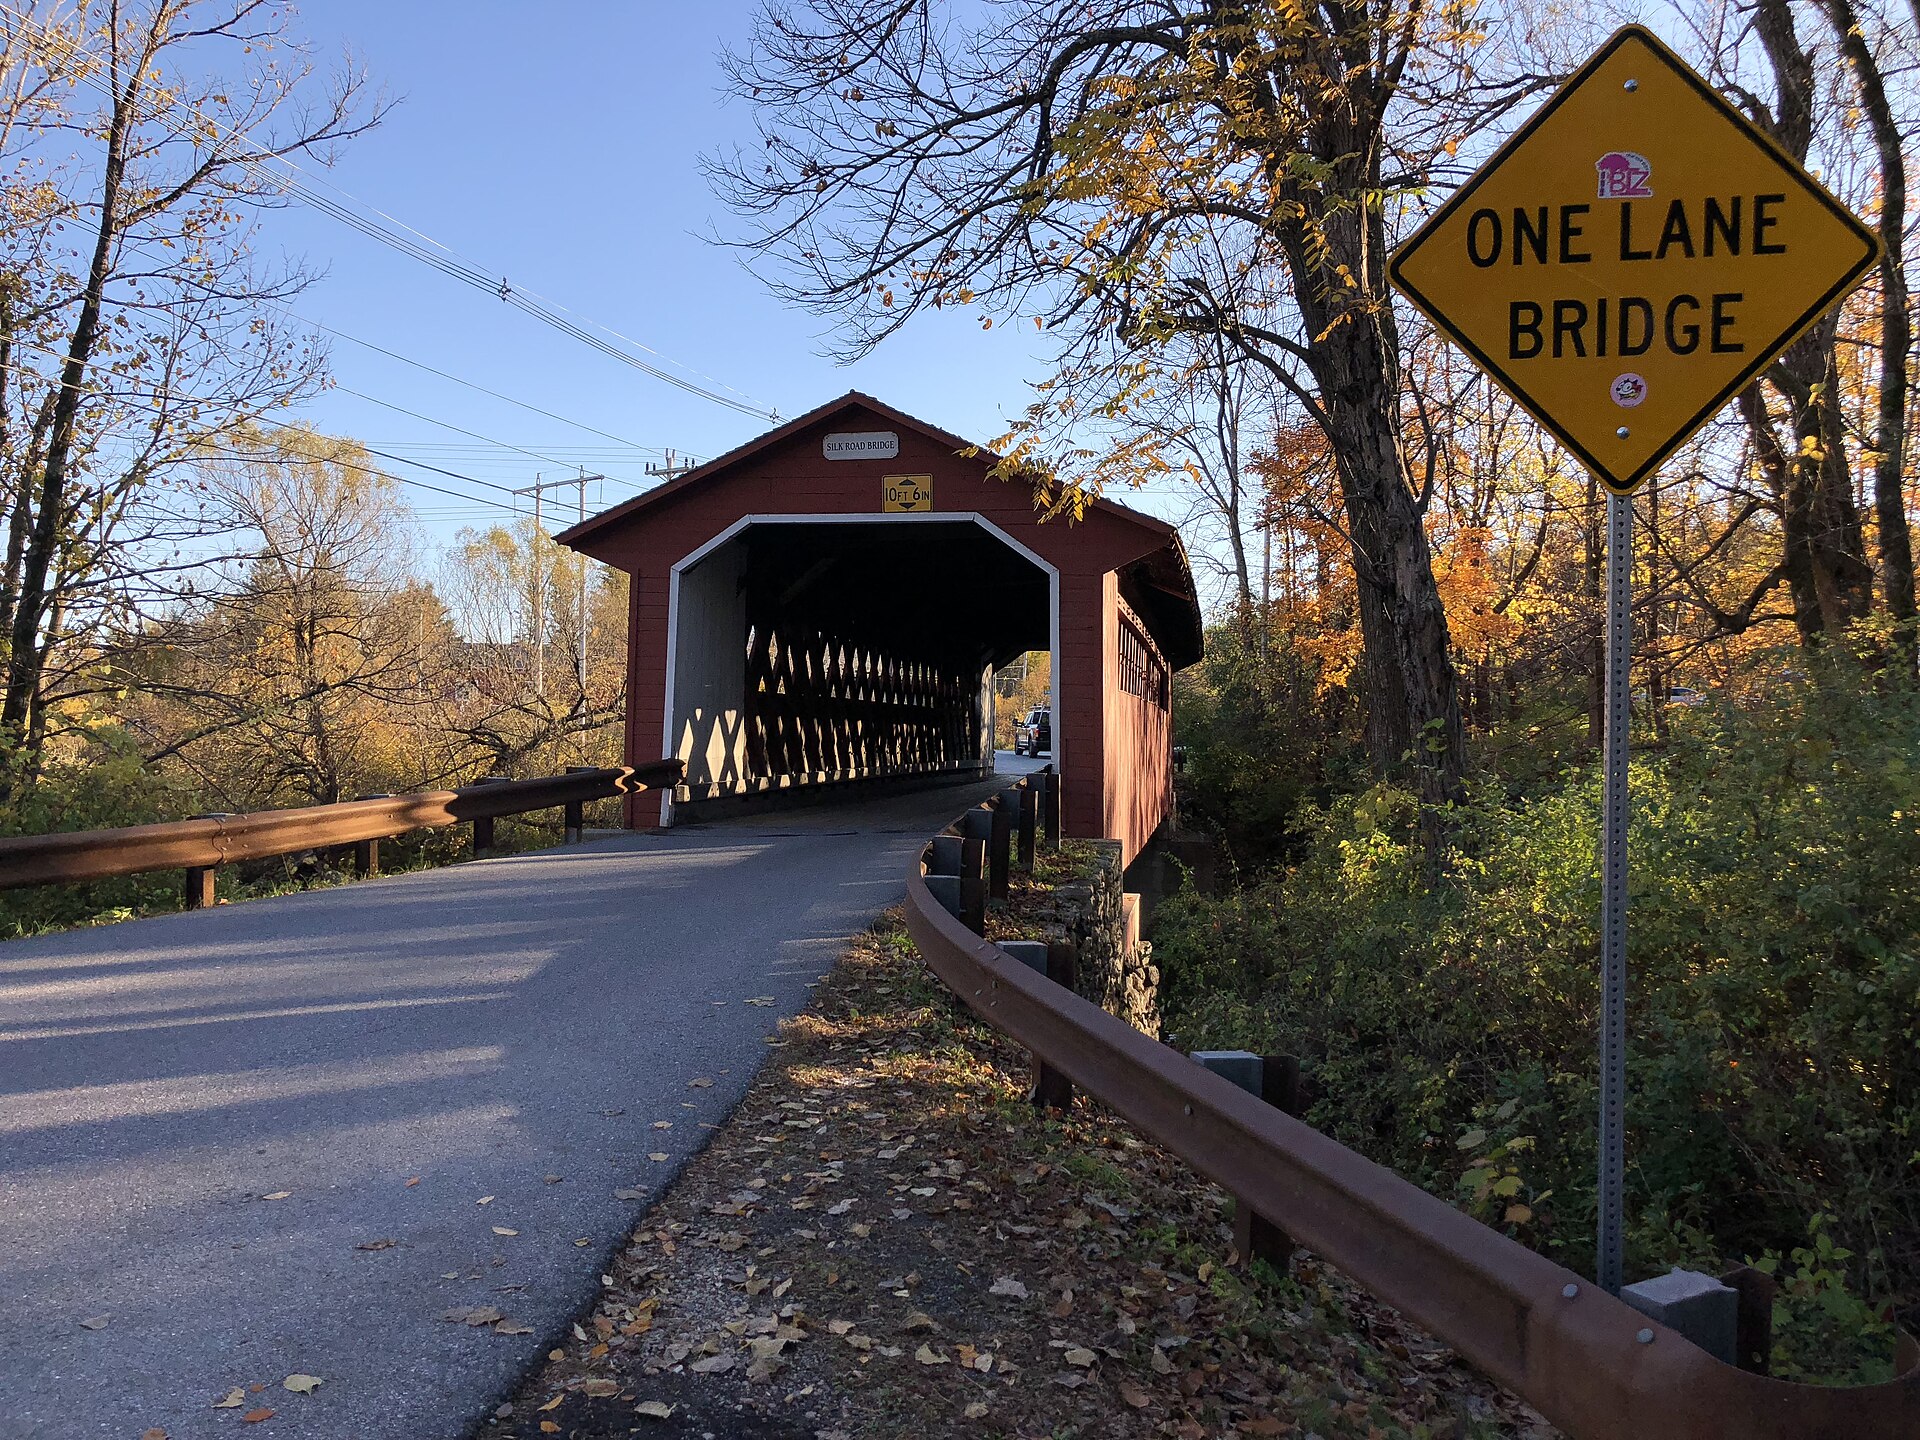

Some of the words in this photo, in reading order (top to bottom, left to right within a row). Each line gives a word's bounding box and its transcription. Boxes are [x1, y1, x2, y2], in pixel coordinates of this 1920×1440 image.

[1467, 204, 1591, 268] ONE
[1620, 194, 1786, 261] LANE
[1509, 293, 1744, 360] BRIDGE
[826, 442, 843, 451] SILK
[845, 441, 866, 451] ROAD
[867, 440, 895, 450] BRIDGE
